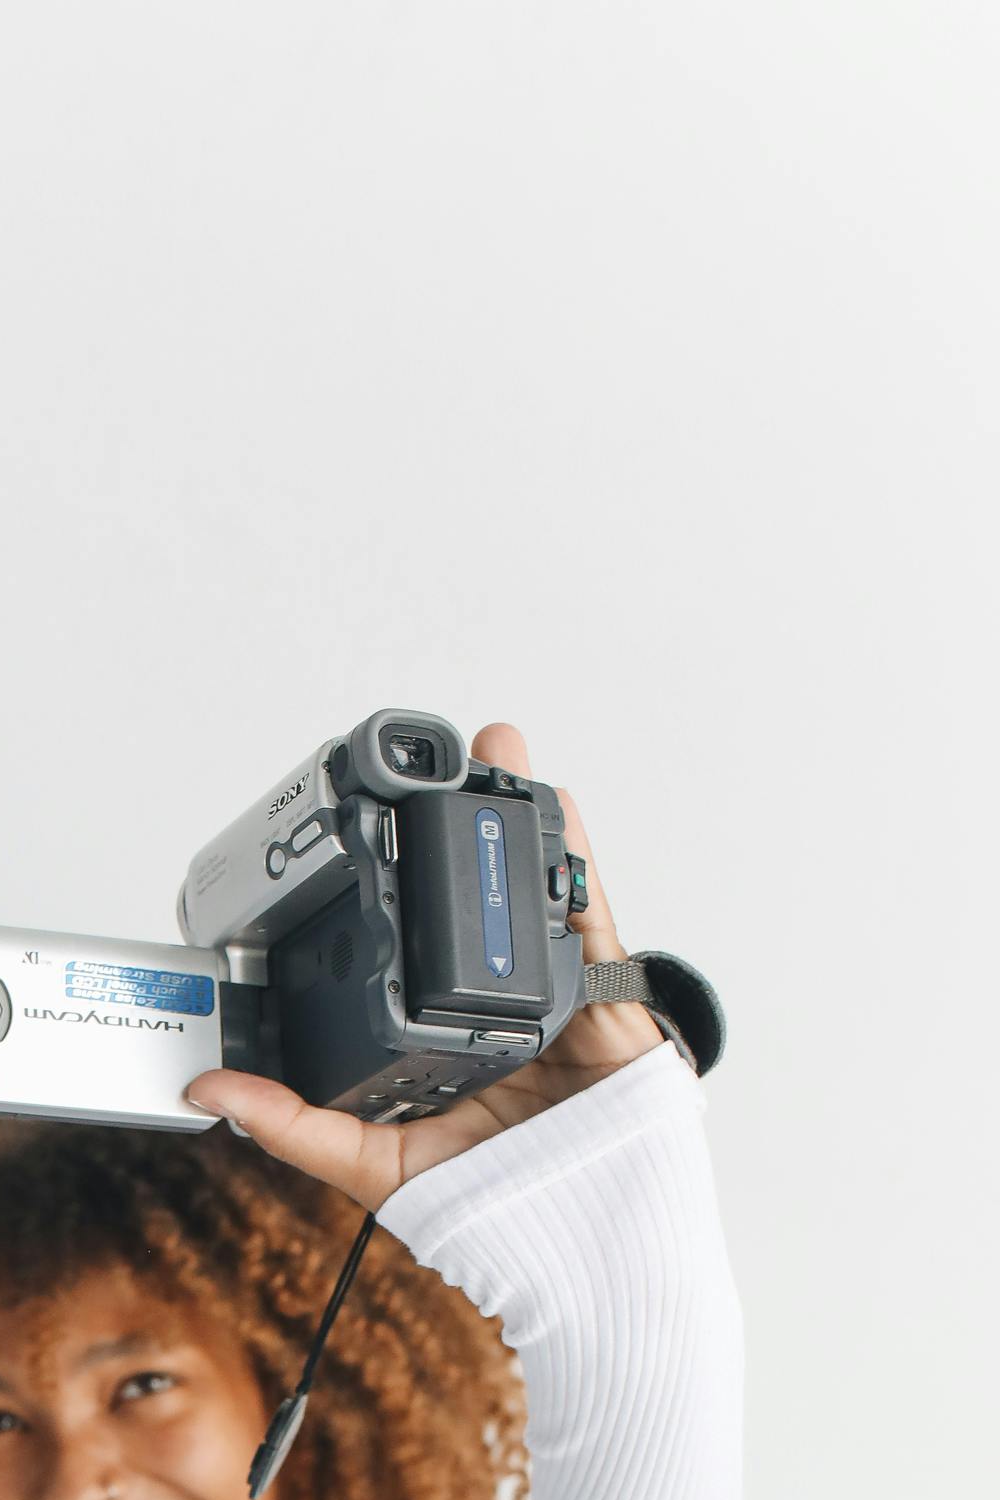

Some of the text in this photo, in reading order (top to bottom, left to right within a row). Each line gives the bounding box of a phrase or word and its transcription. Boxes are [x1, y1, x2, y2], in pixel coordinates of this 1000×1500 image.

[267, 772, 310, 820] SONY
[72, 976, 106, 989] LCD
[74, 961, 193, 986] USB Streaming
[72, 988, 112, 1002] Lens
[109, 978, 147, 994] Panel
[23, 1007, 184, 1033] HANDYCAM
